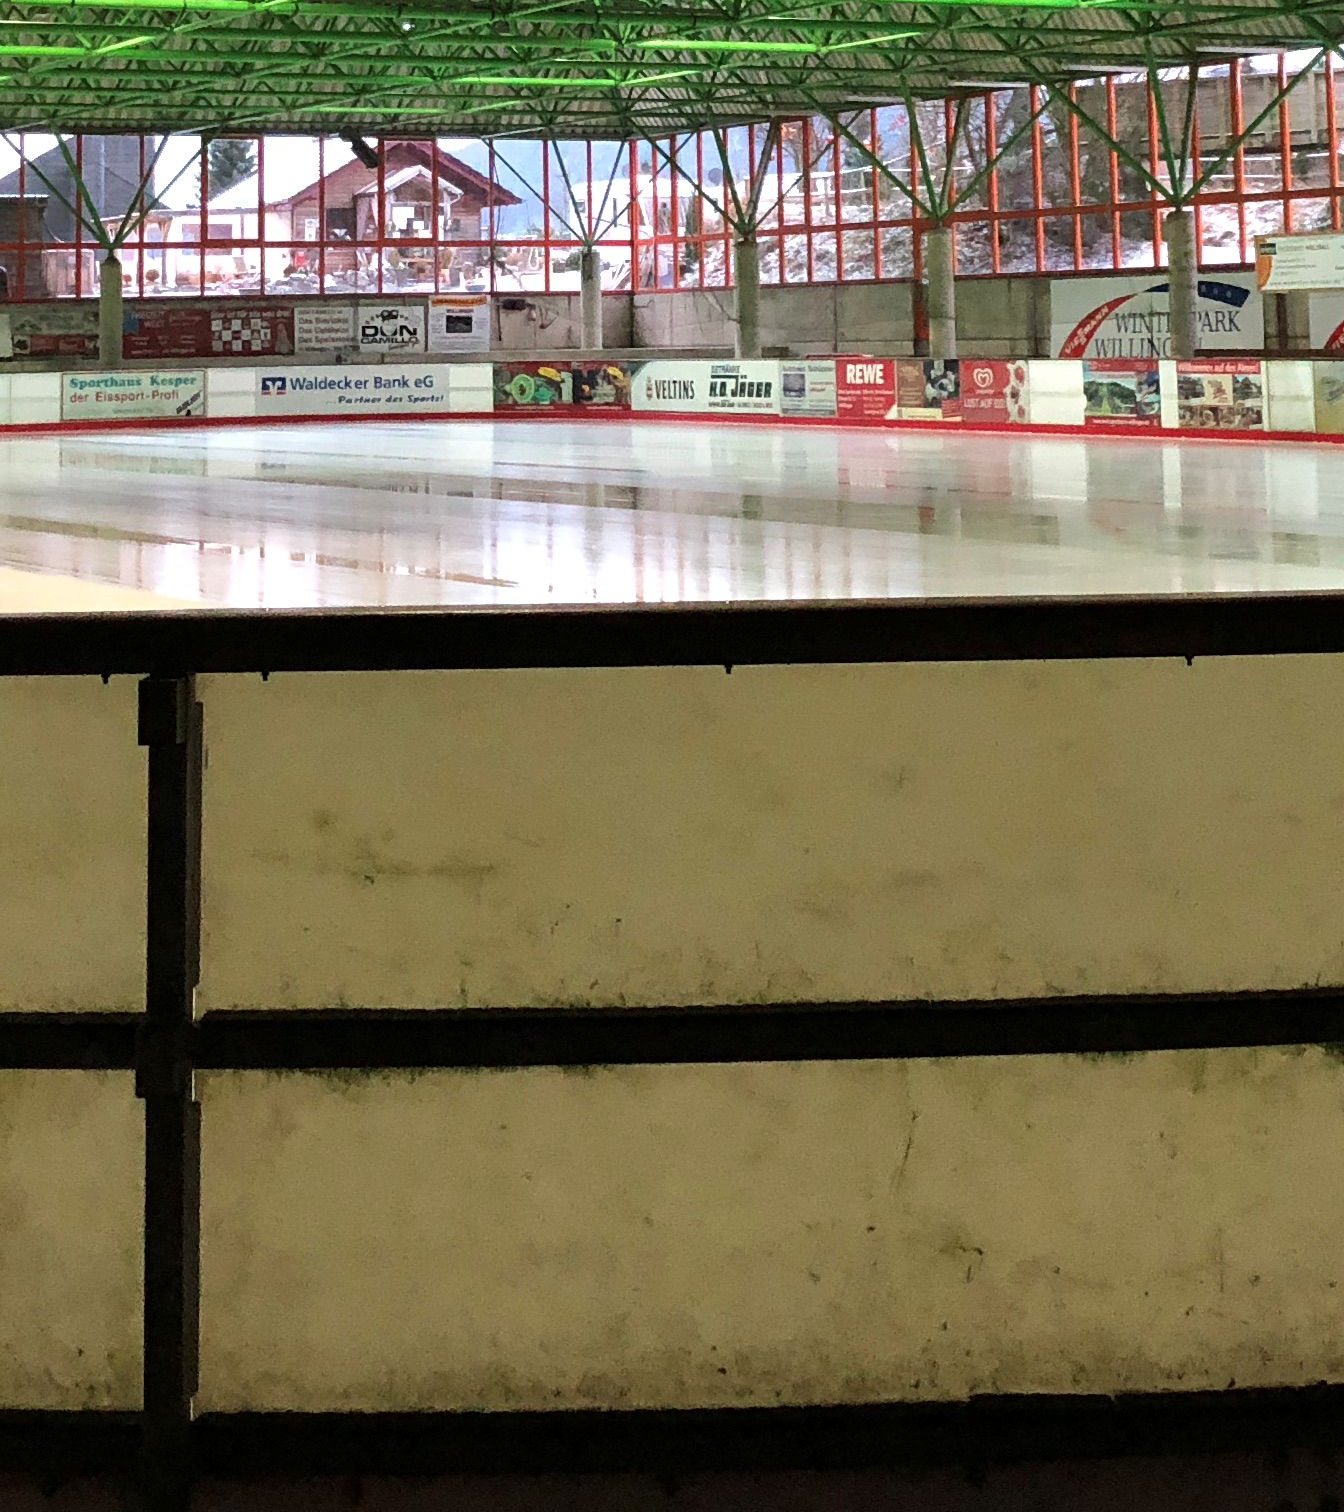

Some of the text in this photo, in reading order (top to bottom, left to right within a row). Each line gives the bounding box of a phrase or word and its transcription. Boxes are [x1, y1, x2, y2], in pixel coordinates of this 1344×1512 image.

[69, 374, 197, 390] Sporthaus Kesper
[290, 374, 434, 391] Waldecker Bank eG
[846, 363, 885, 385] REWE
[70, 389, 179, 404] der Eissport-Profi
[654, 379, 695, 400] VELTINS
